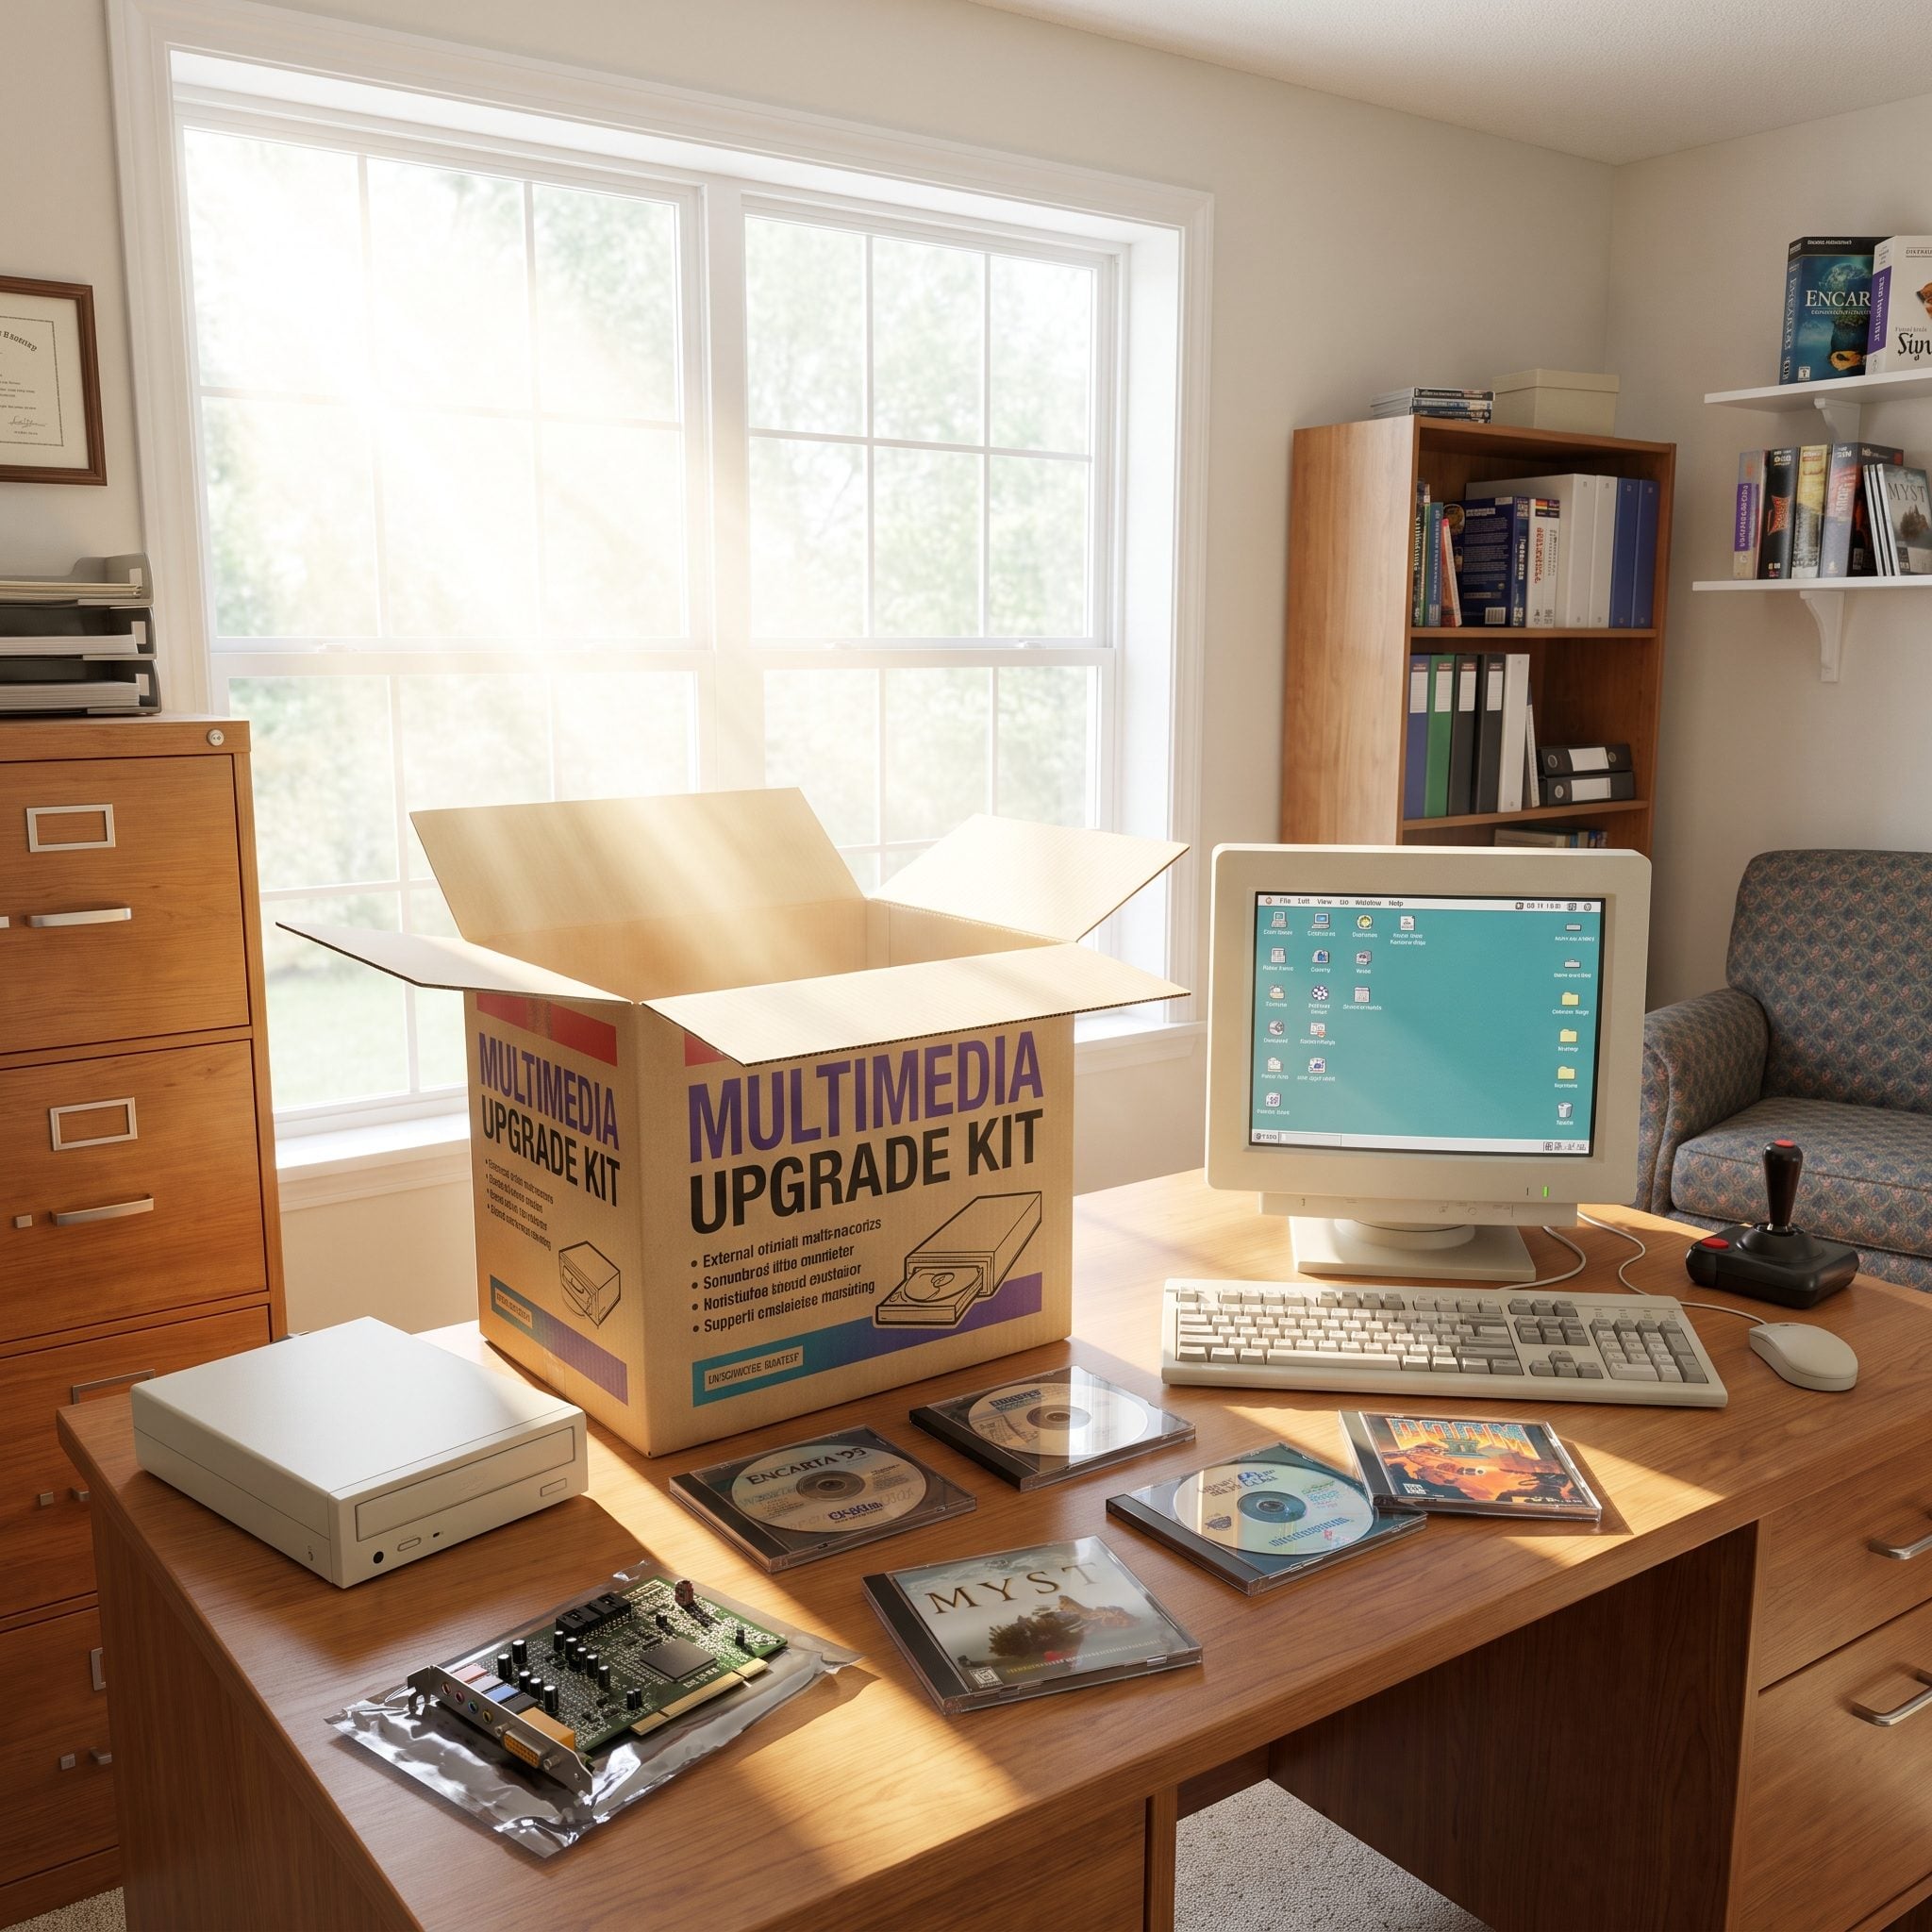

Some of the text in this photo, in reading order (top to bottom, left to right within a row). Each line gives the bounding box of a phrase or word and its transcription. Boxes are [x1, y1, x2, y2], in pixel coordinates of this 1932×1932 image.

[1805, 290, 1872, 307] ENCAR
[1889, 482, 1926, 503] MYST
[478, 1032, 620, 1151] MULTIMEDIA
[689, 1030, 1044, 1163] MULTIMEDIA
[481, 1094, 578, 1186] UPGRADE
[584, 1145, 621, 1208] KIT
[691, 1108, 1043, 1235] UPGRADE KIT
[703, 1244, 754, 1268] External
[746, 1456, 839, 1486] ENCARTA
[924, 1561, 1098, 1615] MYST
